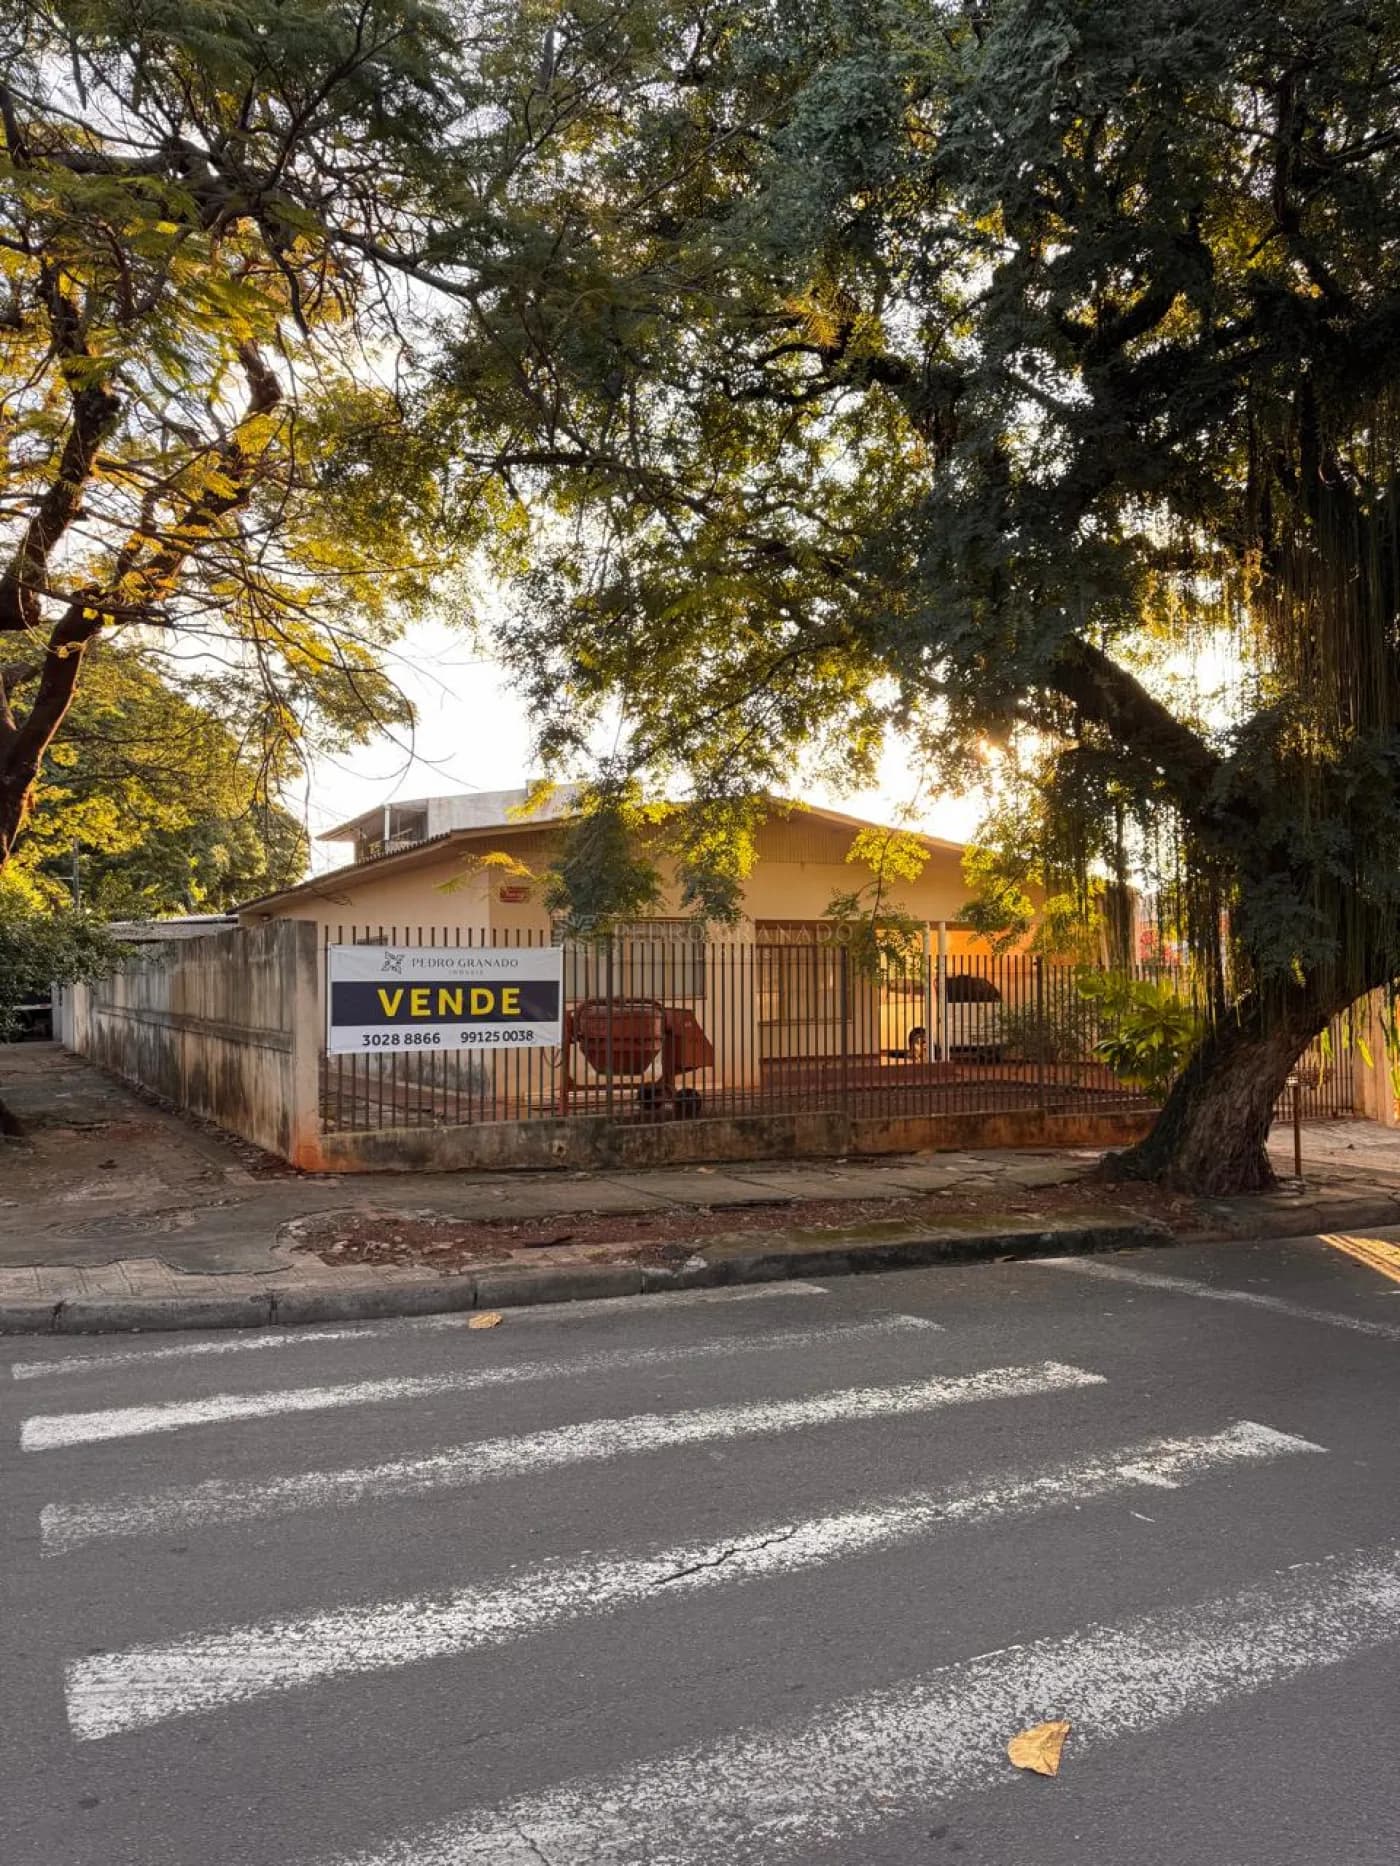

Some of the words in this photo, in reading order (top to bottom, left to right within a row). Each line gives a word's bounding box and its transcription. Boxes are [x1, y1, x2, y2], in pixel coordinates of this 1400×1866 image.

[411, 958, 454, 968] PEDRO
[457, 958, 519, 968] GRANADO
[377, 987, 521, 1017] VENDE
[362, 1033, 401, 1046] 3028
[403, 1032, 441, 1045] 8866
[460, 1031, 500, 1043] 99125
[502, 1030, 534, 1042] 0038
